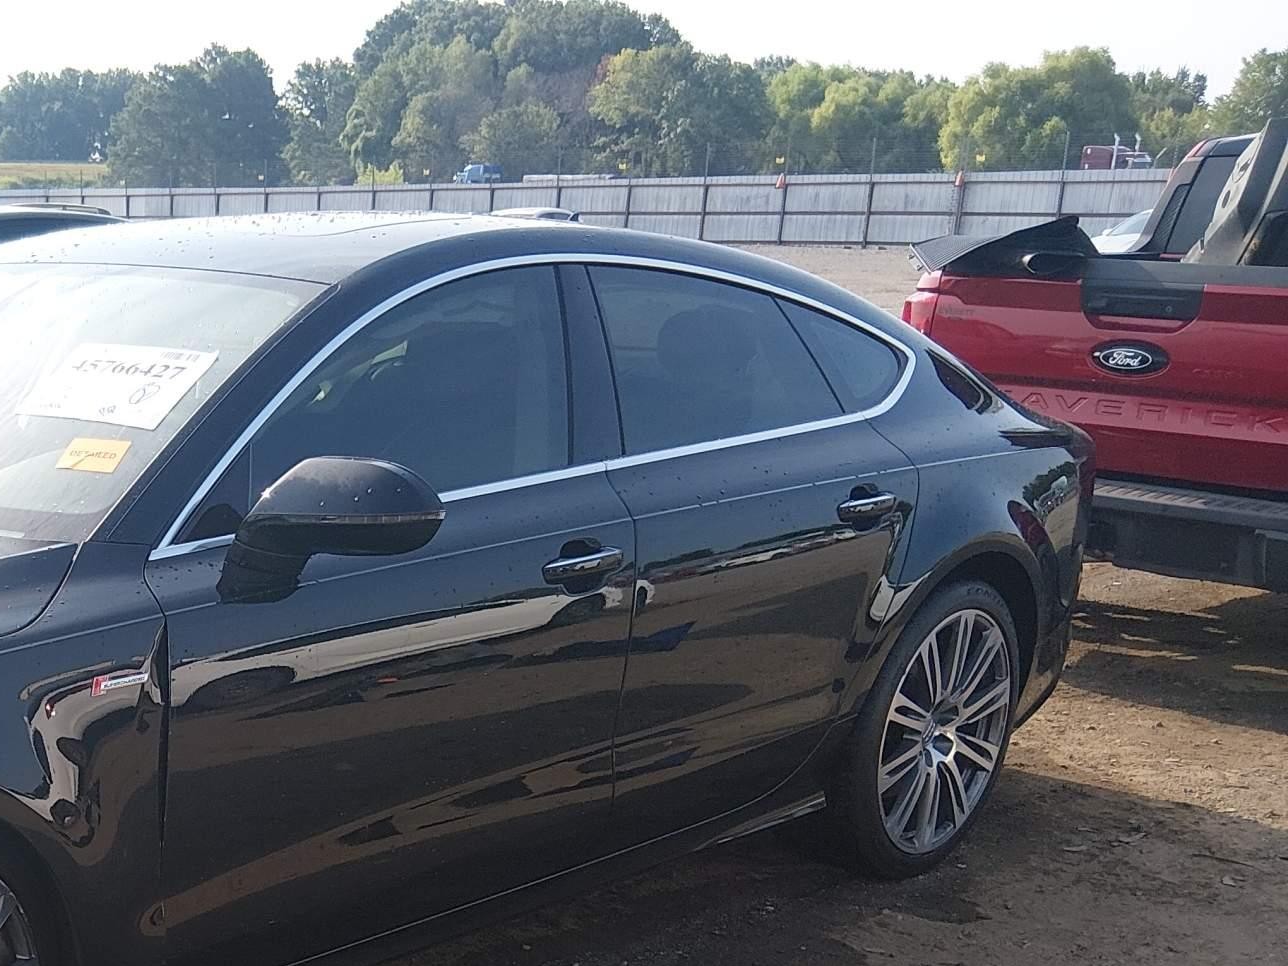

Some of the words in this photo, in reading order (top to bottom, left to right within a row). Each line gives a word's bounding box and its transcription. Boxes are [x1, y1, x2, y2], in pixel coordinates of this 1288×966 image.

[1108, 350, 1143, 367] Ford
[71, 359, 188, 380] 45766427
[1004, 389, 1285, 433] AVERICK
